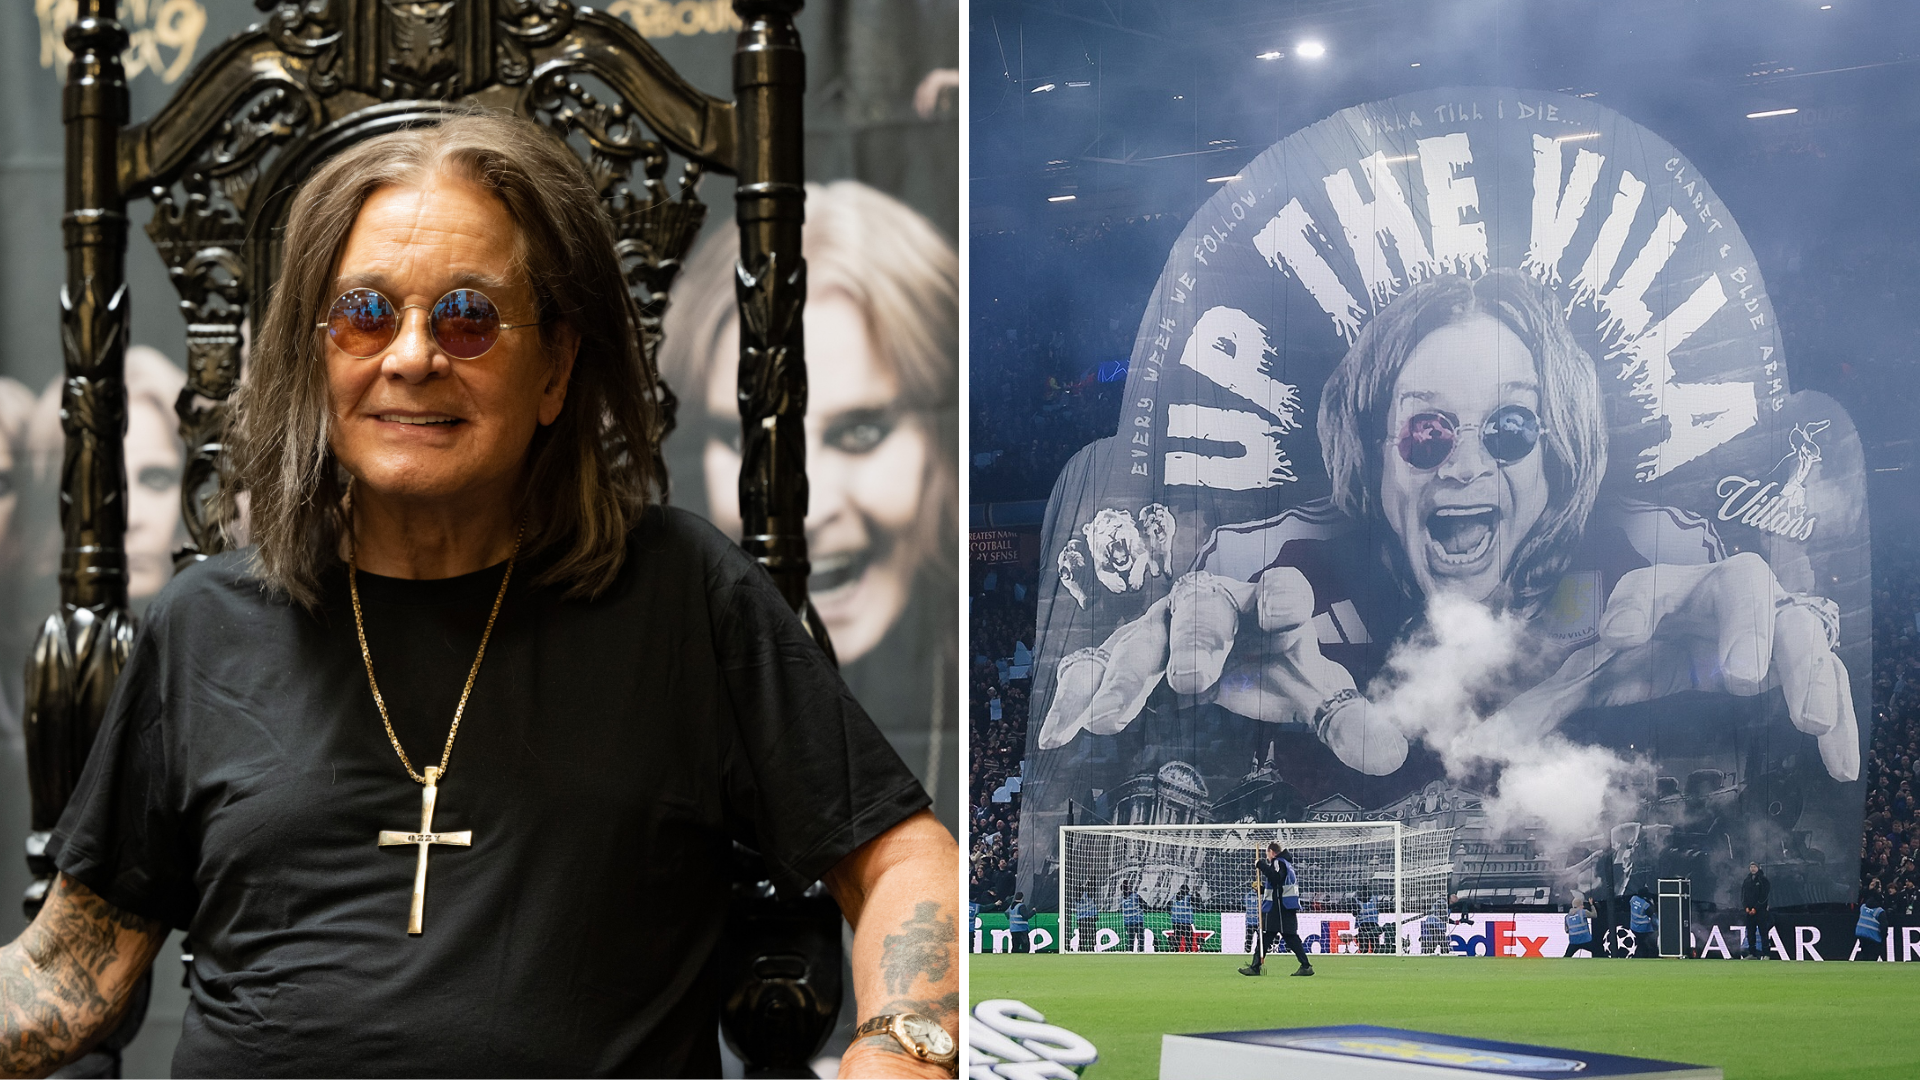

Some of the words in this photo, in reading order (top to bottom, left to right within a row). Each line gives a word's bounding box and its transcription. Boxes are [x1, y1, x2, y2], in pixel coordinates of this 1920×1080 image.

[1434, 102, 1483, 123] TILL
[1497, 100, 1504, 120] I
[1164, 305, 1304, 491] UP
[1252, 133, 1491, 347] THE
[1518, 133, 1758, 483] VILLA
[1665, 157, 1723, 233] CLARET
[1730, 266, 1765, 331] BLUE
[1760, 346, 1784, 412] ARMY
[1131, 397, 1155, 477] EVERY
[1143, 316, 1177, 382] WEEK
[1171, 272, 1197, 304] WE
[1312, 813, 1355, 822] ASTON
[1421, 921, 1549, 957] edEx
